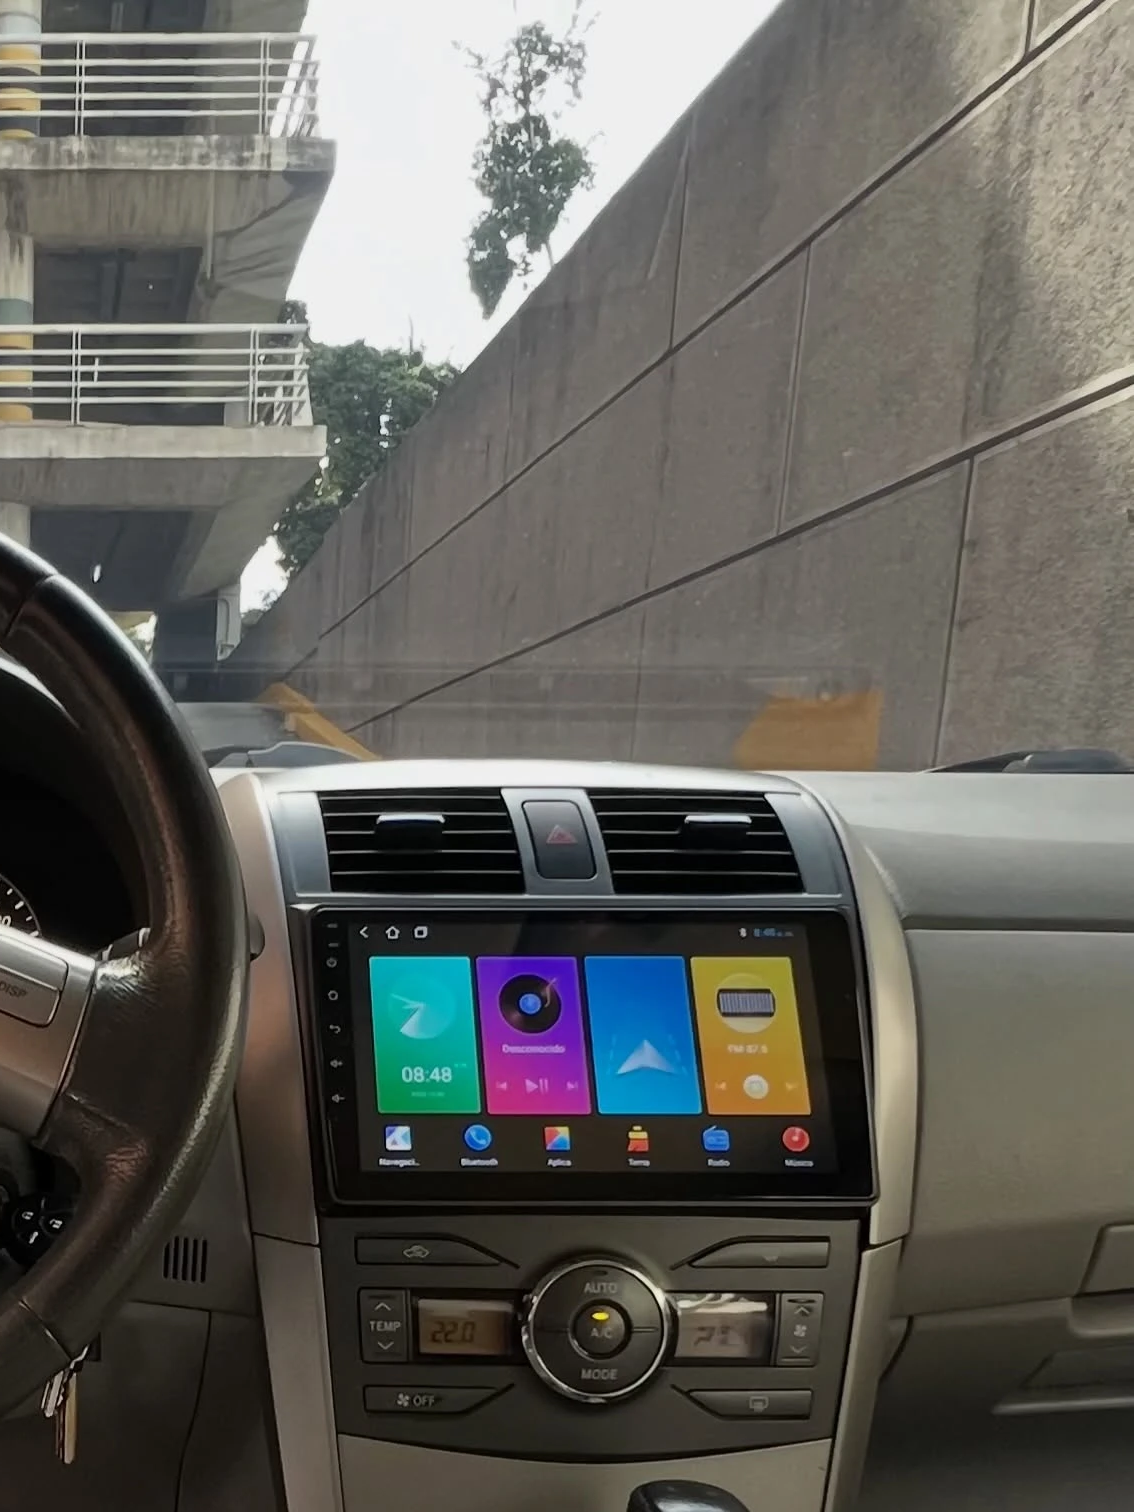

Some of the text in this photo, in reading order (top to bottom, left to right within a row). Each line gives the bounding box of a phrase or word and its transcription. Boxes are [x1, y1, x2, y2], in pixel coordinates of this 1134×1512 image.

[401, 1066, 453, 1083] 08:48
[460, 1157, 499, 1167] Bluetooth
[707, 1158, 731, 1167] Radio
[583, 1281, 618, 1294] AUTO
[369, 1320, 402, 1332] TEMP
[590, 1328, 614, 1339] A/C
[581, 1368, 618, 1380] MODE
[412, 1395, 435, 1407] OFF
